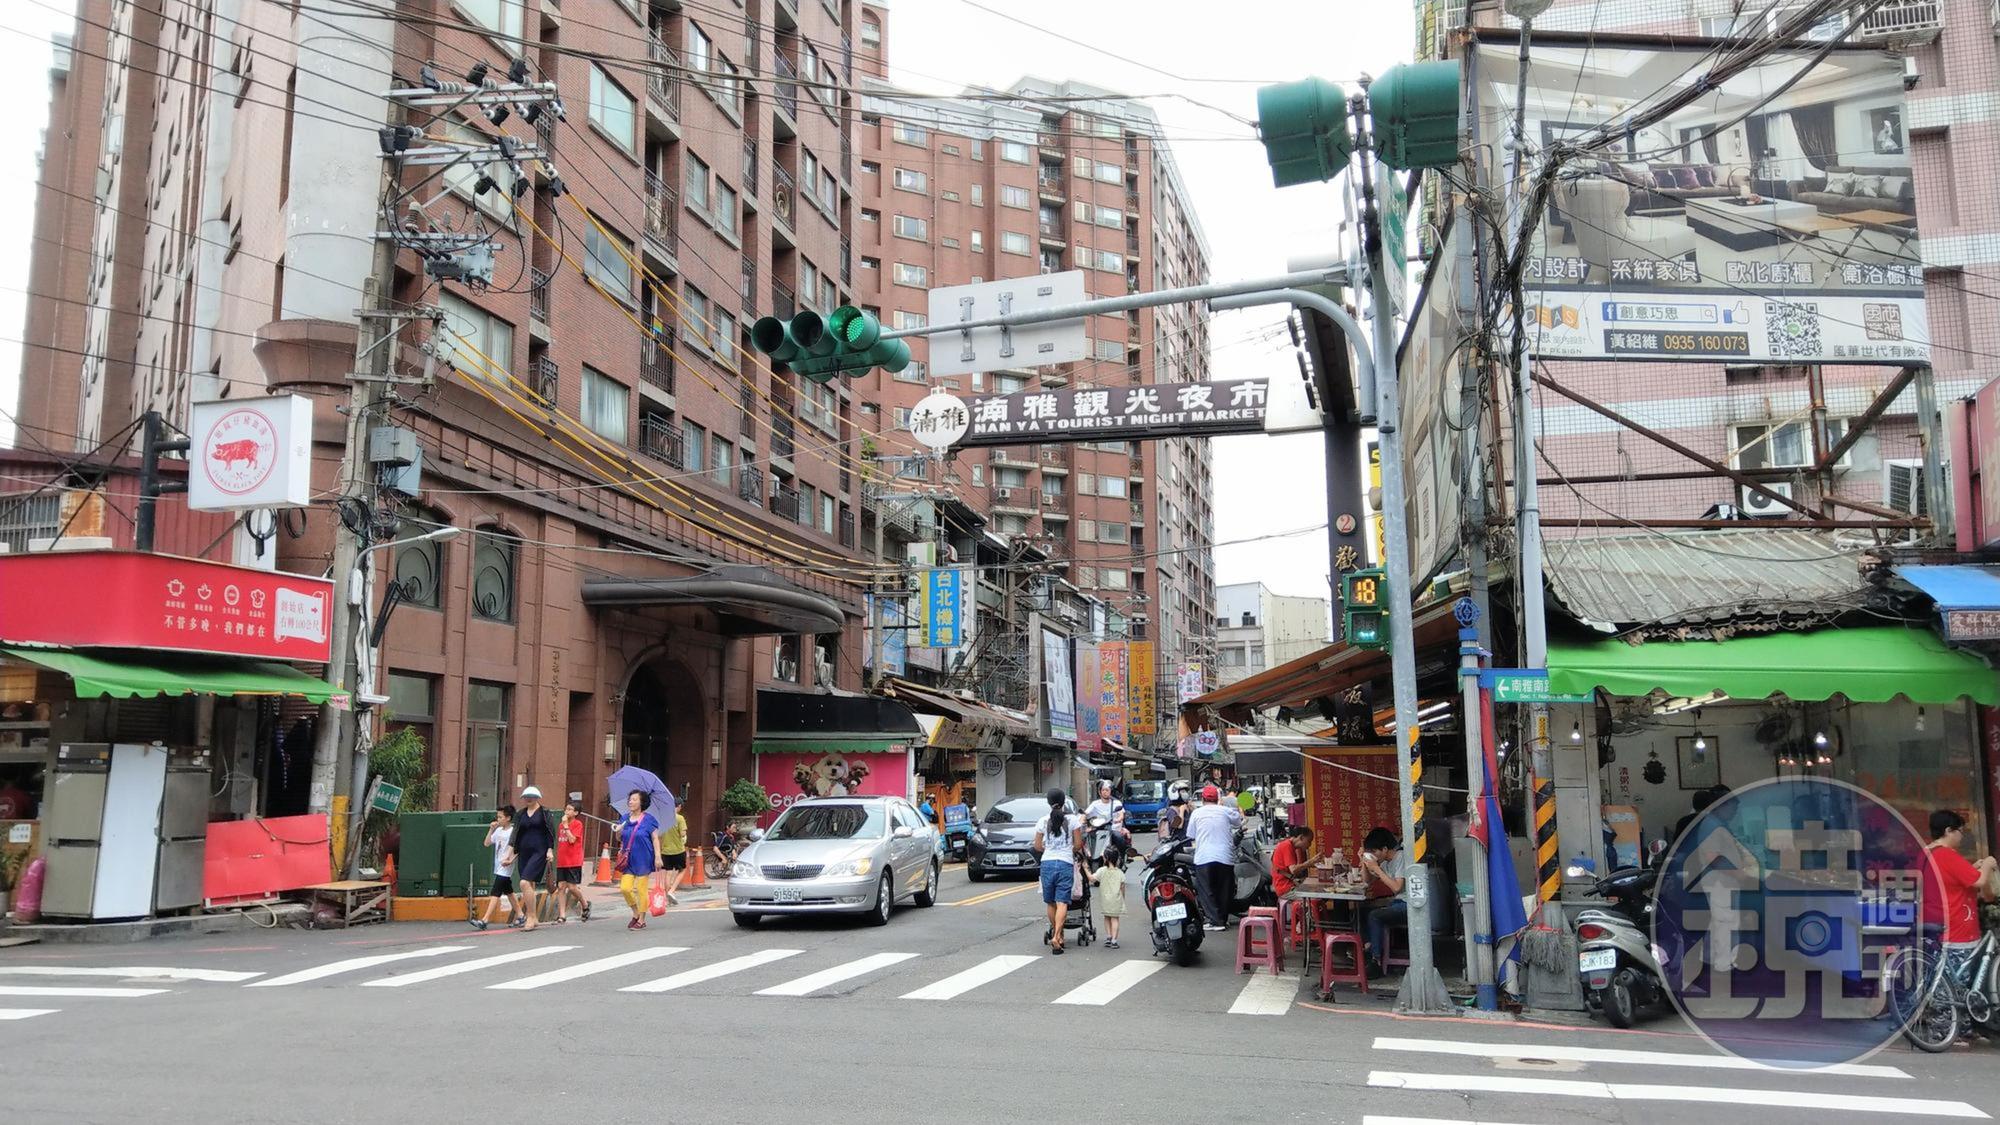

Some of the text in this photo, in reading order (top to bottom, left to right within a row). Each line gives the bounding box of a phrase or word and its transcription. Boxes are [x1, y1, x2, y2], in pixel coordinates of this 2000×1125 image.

[1526, 257, 1586, 278] 內設計
[1620, 305, 1679, 320] 創意巧思
[1664, 335, 1695, 350] 0935
[1699, 336, 1720, 350] 160
[1723, 336, 1747, 351] 073
[974, 381, 1268, 423] 湳雅觀光夜市
[974, 407, 1267, 434] NAN YA TOURIST NIGHT MARKET
[1340, 515, 1352, 532] 2
[1356, 578, 1376, 604] 18
